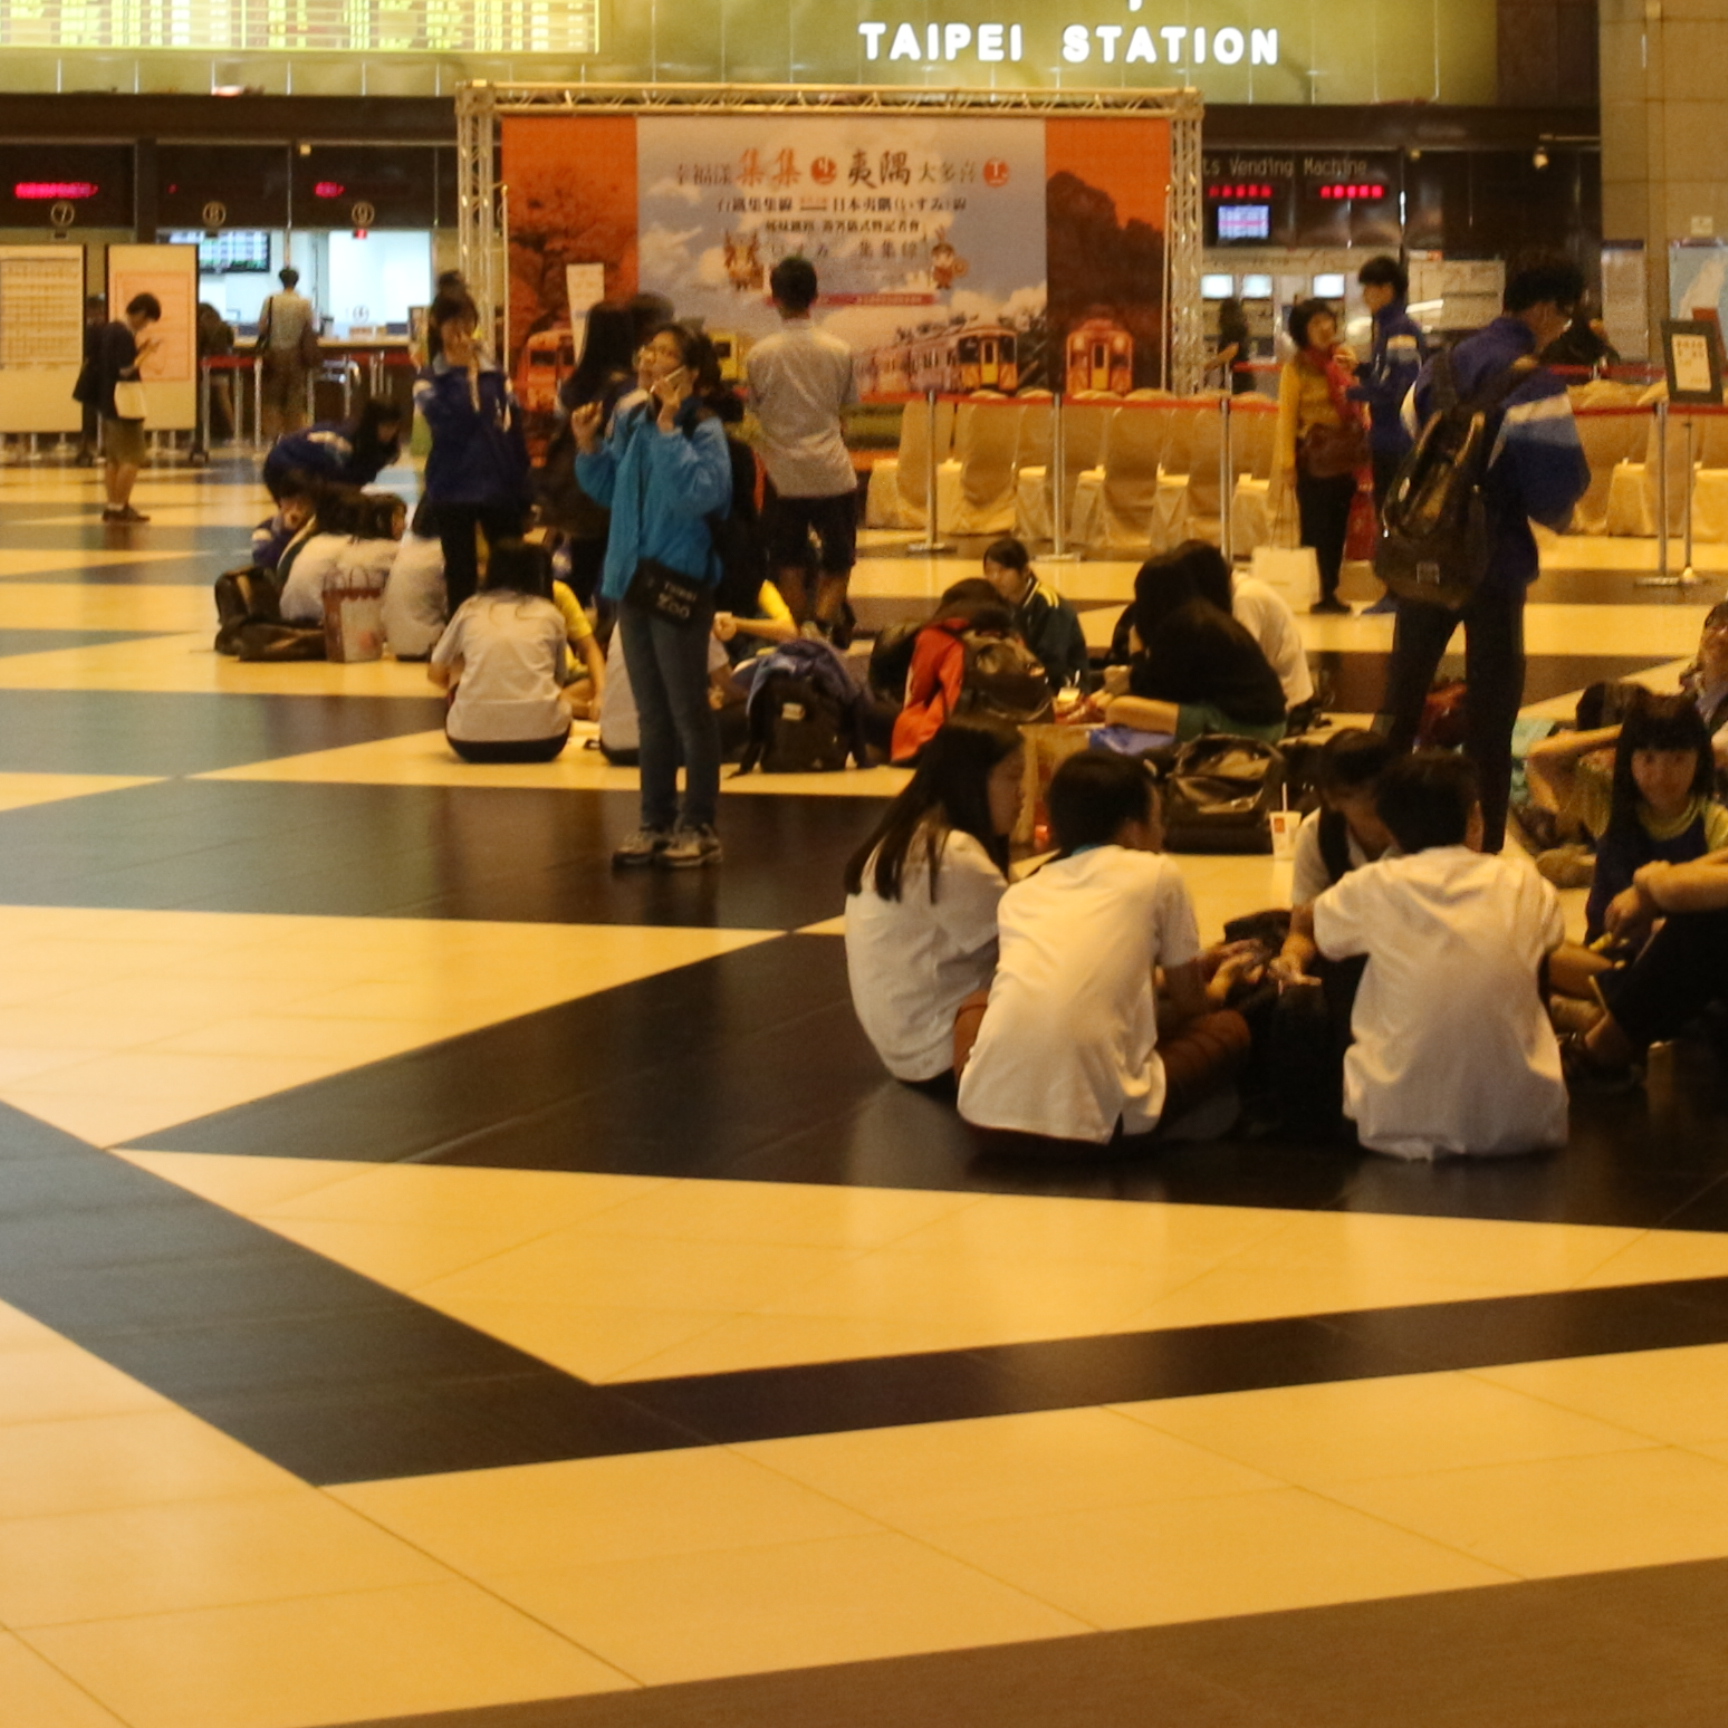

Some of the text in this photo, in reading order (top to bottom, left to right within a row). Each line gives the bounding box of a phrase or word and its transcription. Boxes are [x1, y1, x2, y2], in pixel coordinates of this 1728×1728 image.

[859, 21, 1280, 66] TAIPEI STATION
[1229, 156, 1294, 178] Vending
[1303, 156, 1369, 177] Machine
